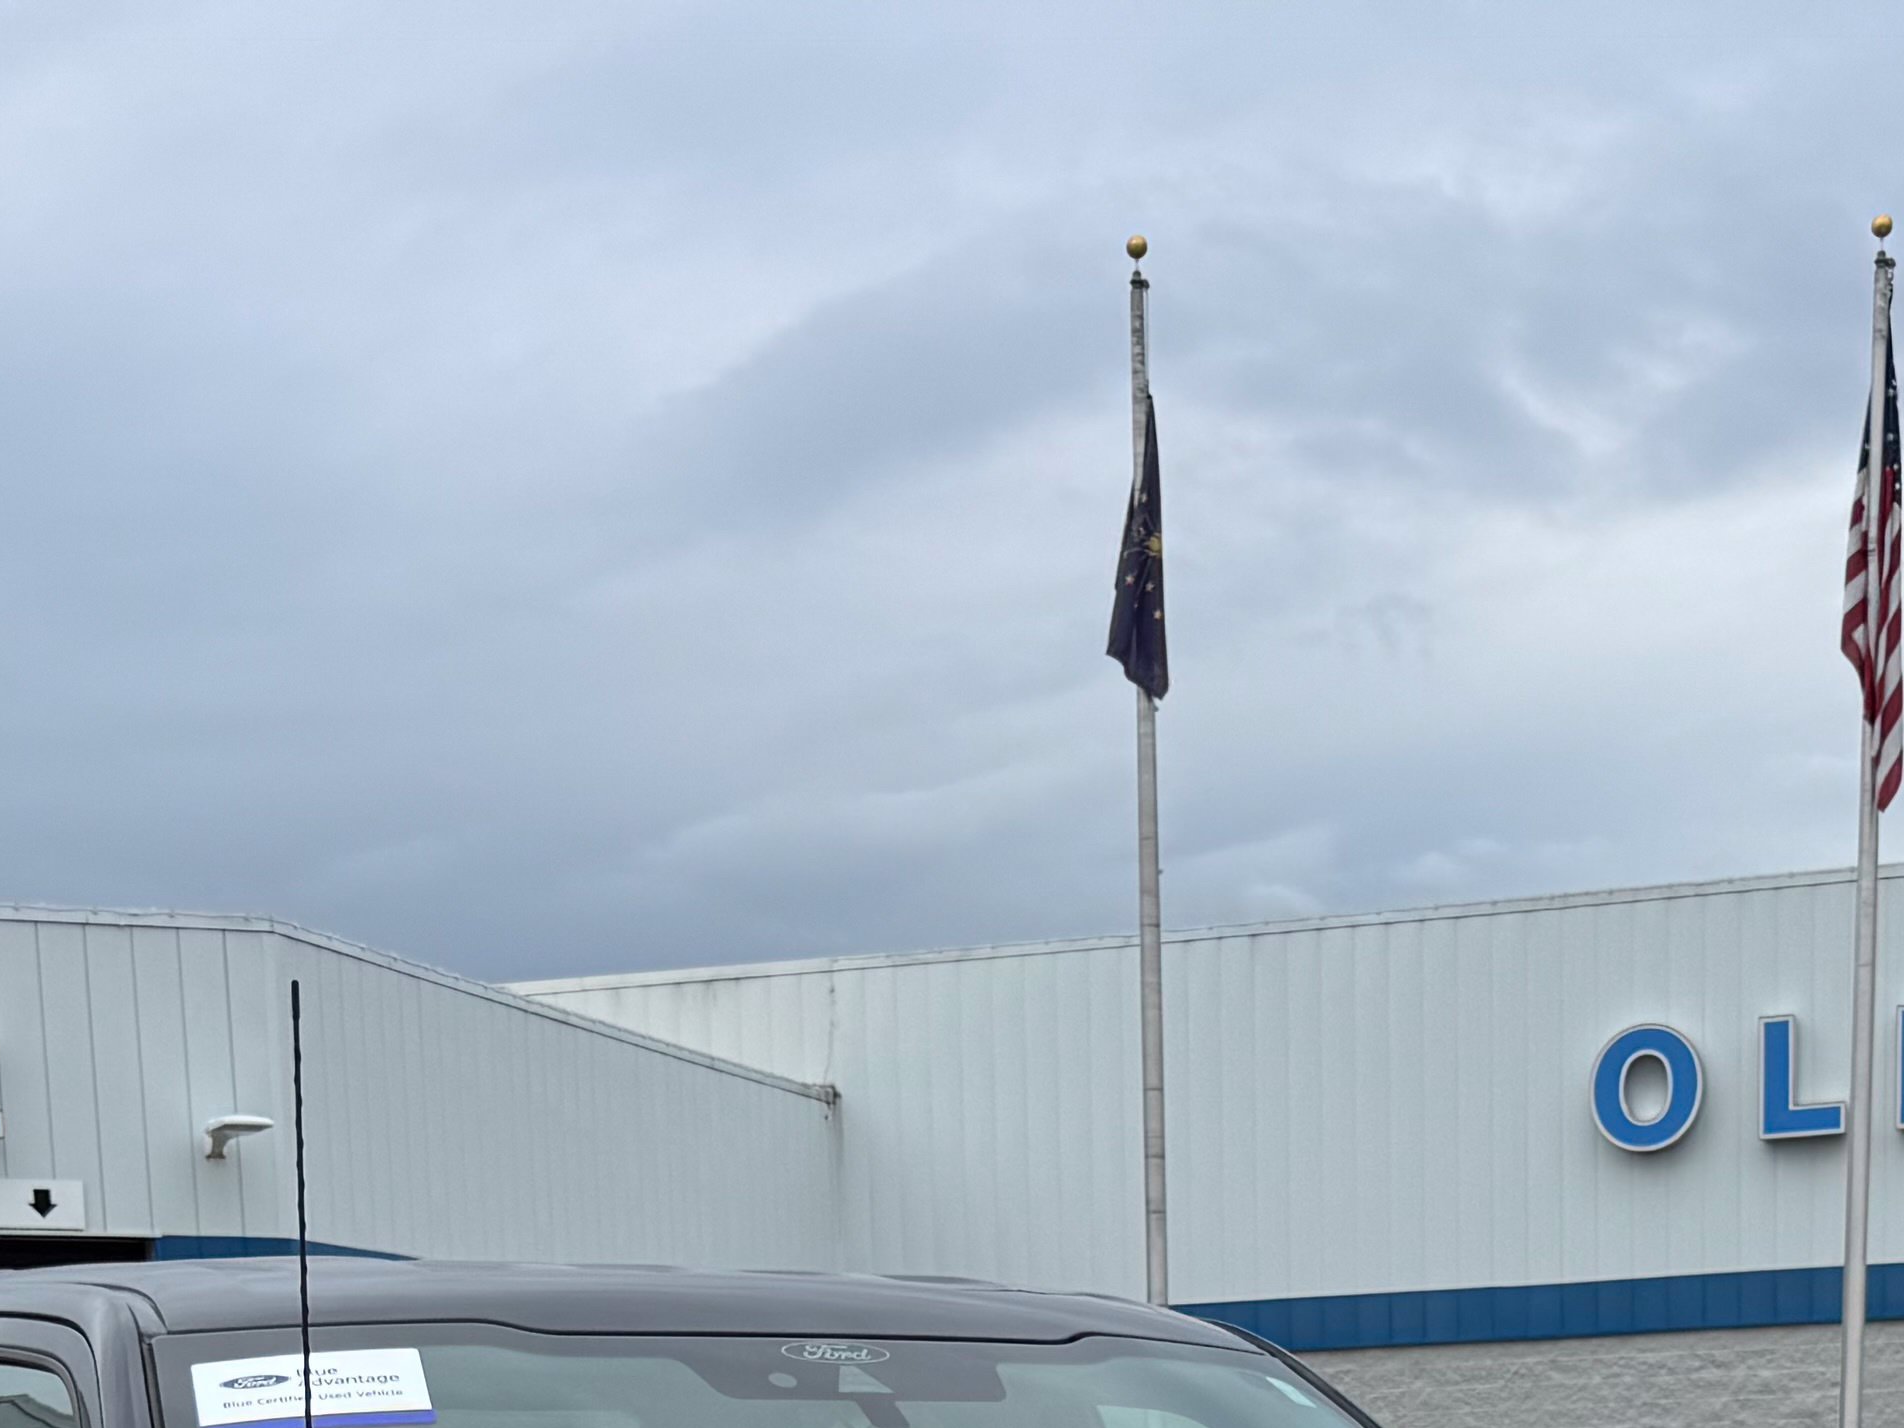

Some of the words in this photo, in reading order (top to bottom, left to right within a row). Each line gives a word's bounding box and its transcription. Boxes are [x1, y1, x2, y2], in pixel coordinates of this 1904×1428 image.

[803, 1344, 872, 1360] Ford
[223, 1400, 253, 1409] Blue
[257, 1394, 313, 1406] Certifie
[318, 1390, 352, 1401] Used
[356, 1388, 403, 1398] Vehicle
